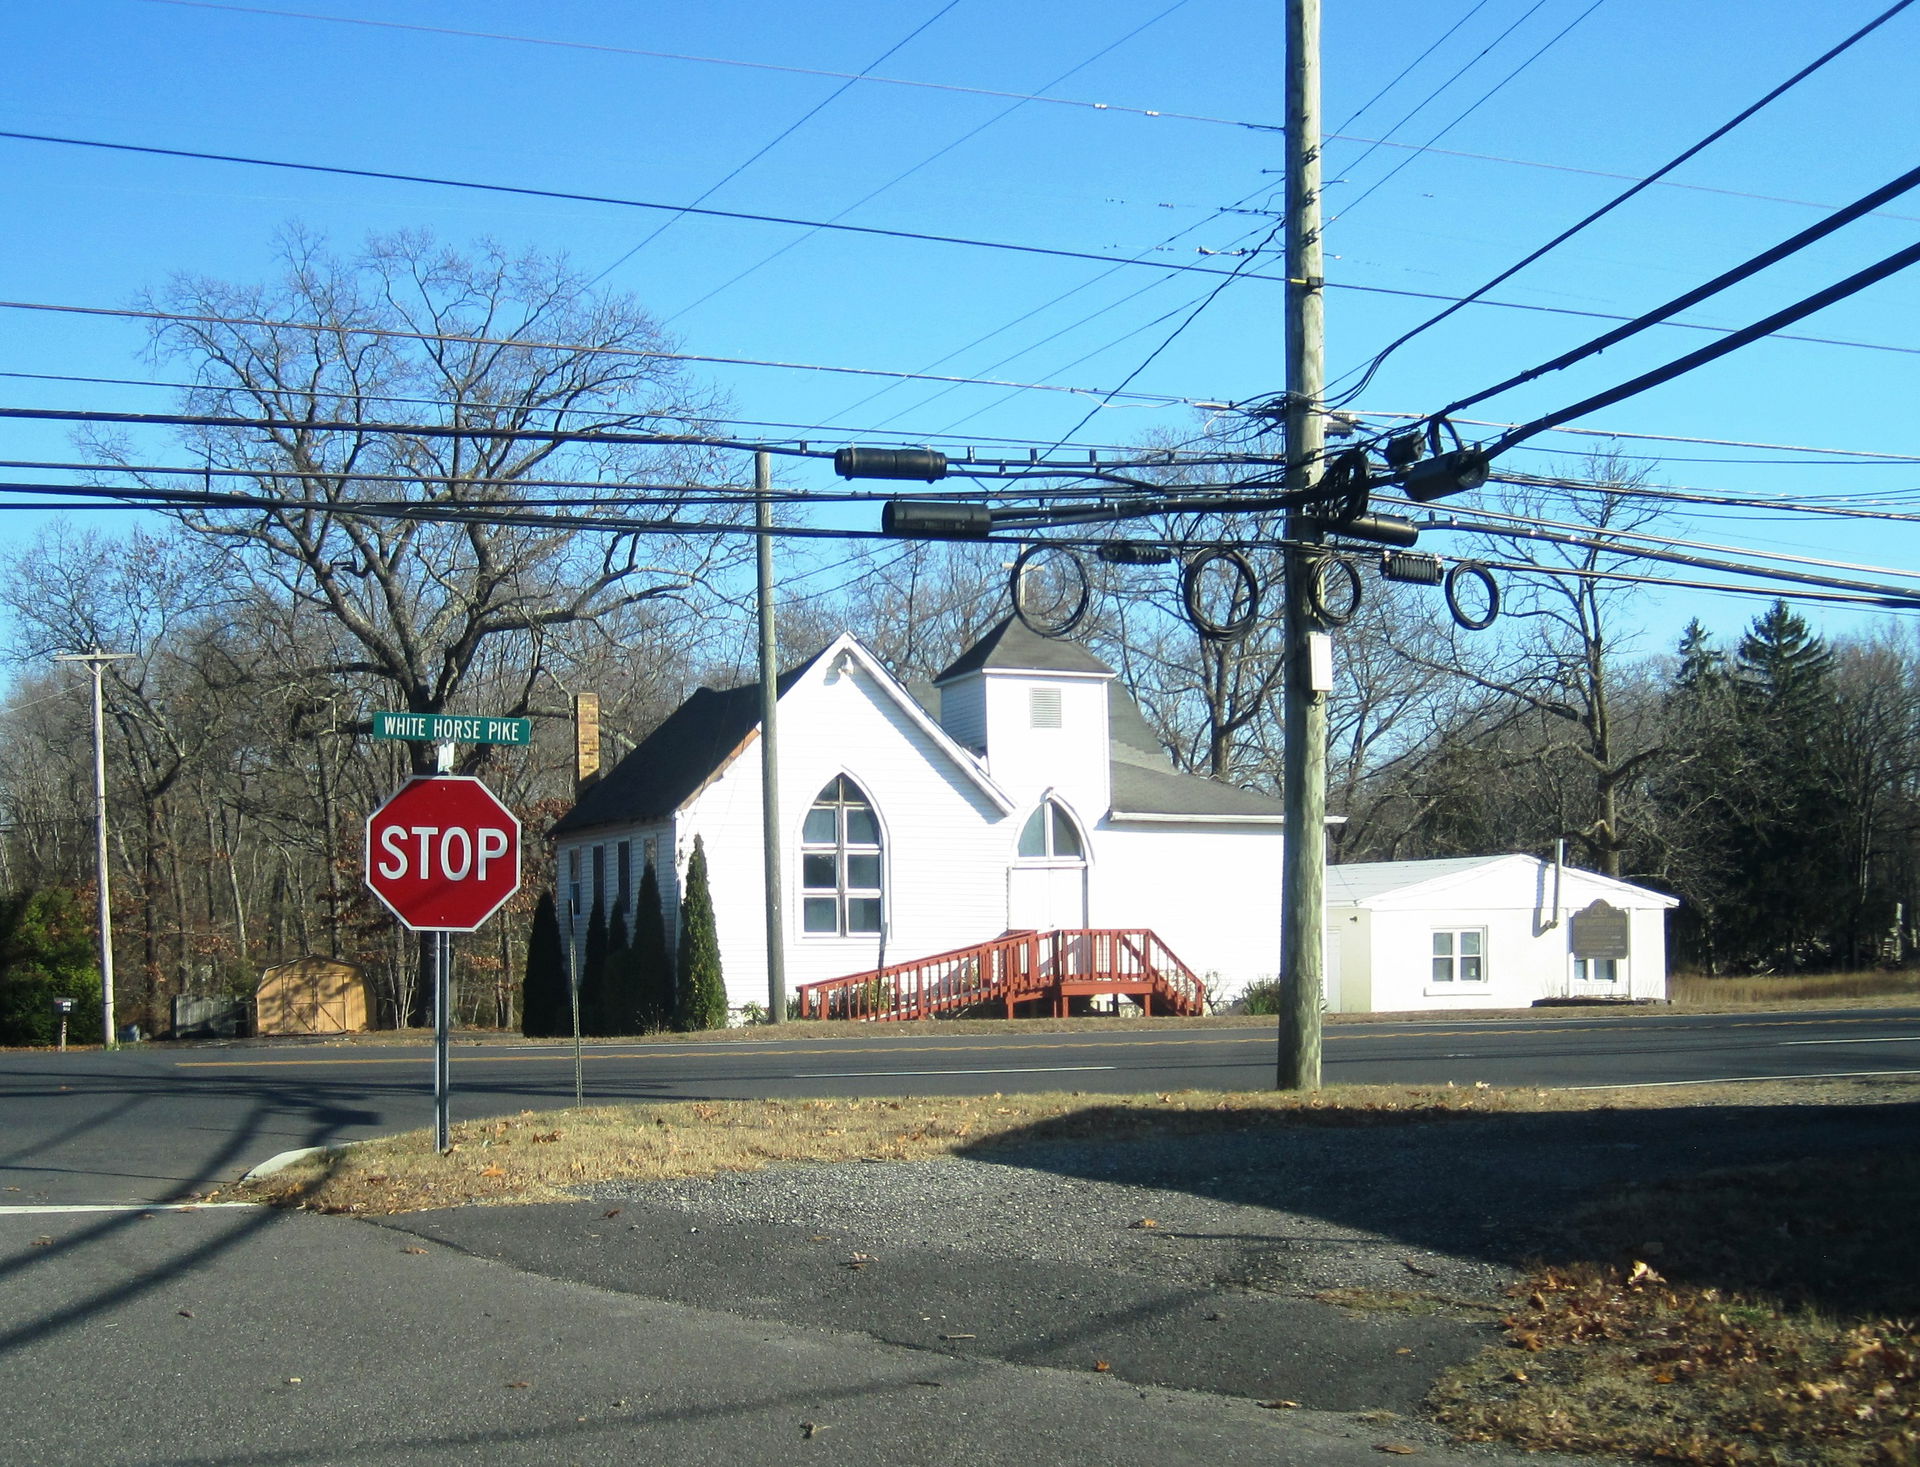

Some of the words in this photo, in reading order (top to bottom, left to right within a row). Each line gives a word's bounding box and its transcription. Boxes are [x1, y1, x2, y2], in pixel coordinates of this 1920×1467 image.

[384, 716, 426, 737] WHITE
[433, 718, 481, 739] HORSE
[488, 721, 520, 741] PIKE
[378, 825, 508, 881] STOP
